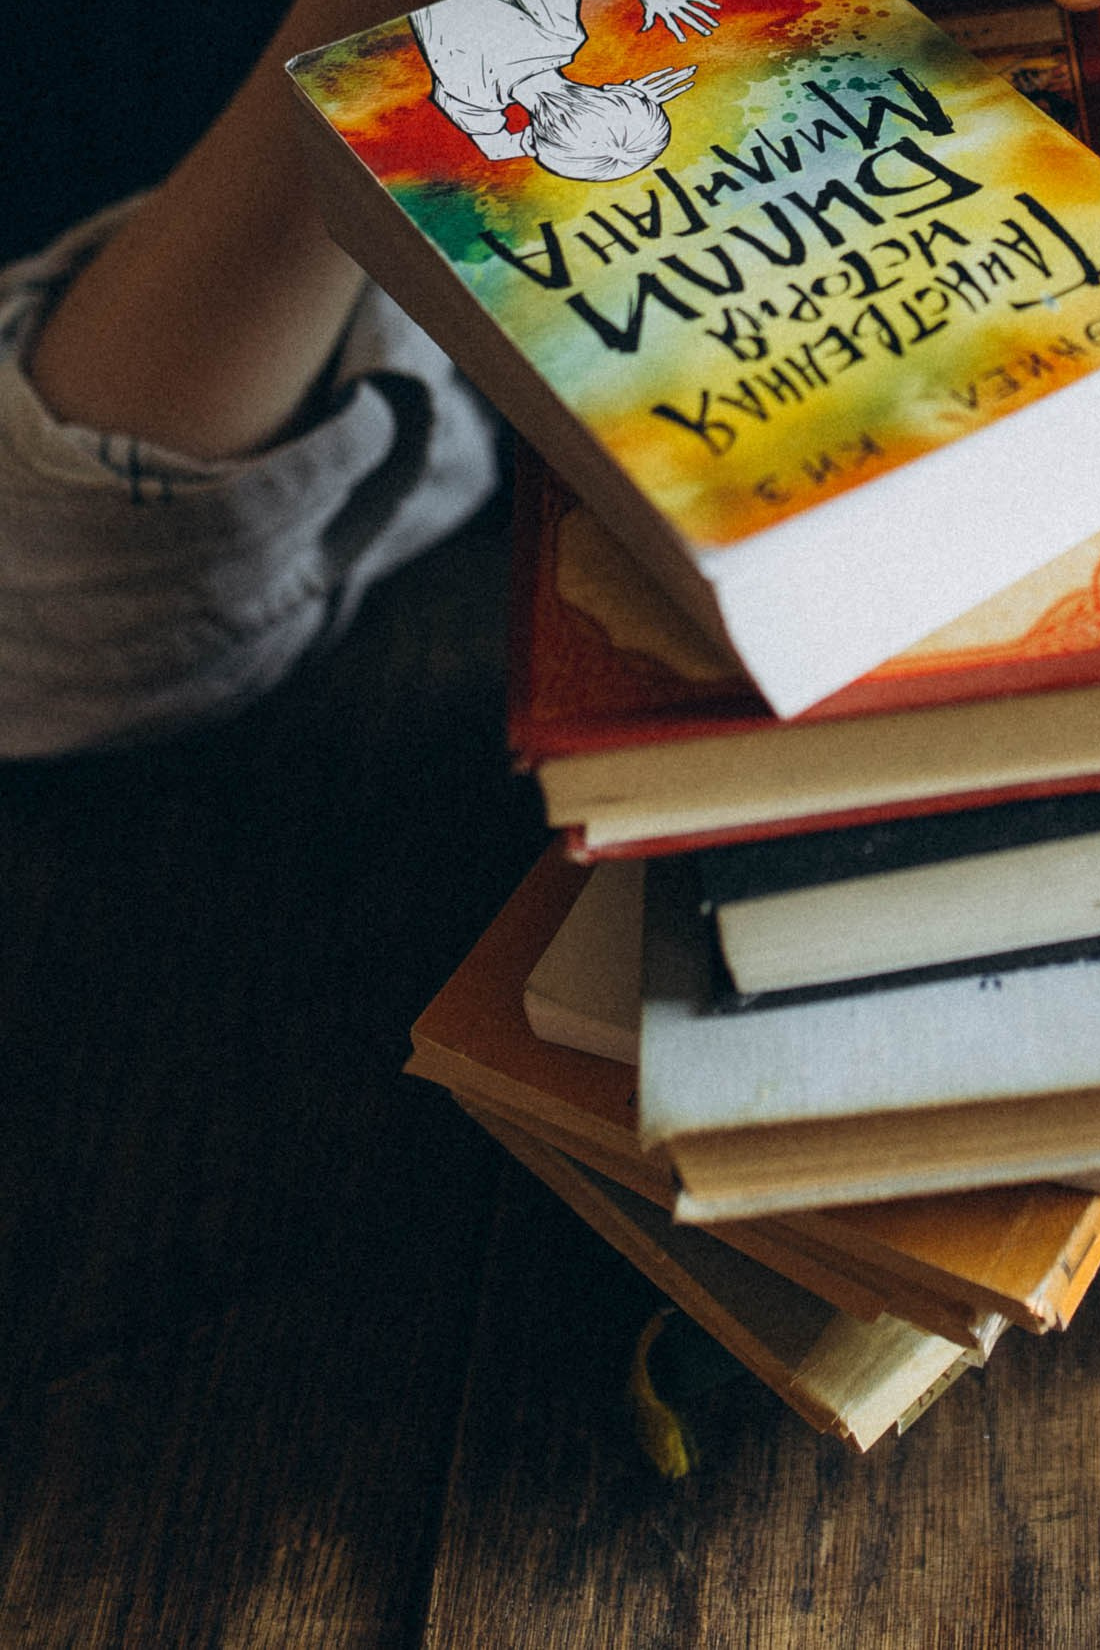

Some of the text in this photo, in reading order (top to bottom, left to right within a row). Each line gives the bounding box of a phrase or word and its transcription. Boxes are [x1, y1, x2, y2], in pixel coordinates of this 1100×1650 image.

[478, 67, 956, 289] МИЛЛИГАНА
[566, 136, 983, 354] БИЛЛИ
[705, 218, 970, 362] ИСТОРИЯ
[753, 432, 886, 505] КИЗ
